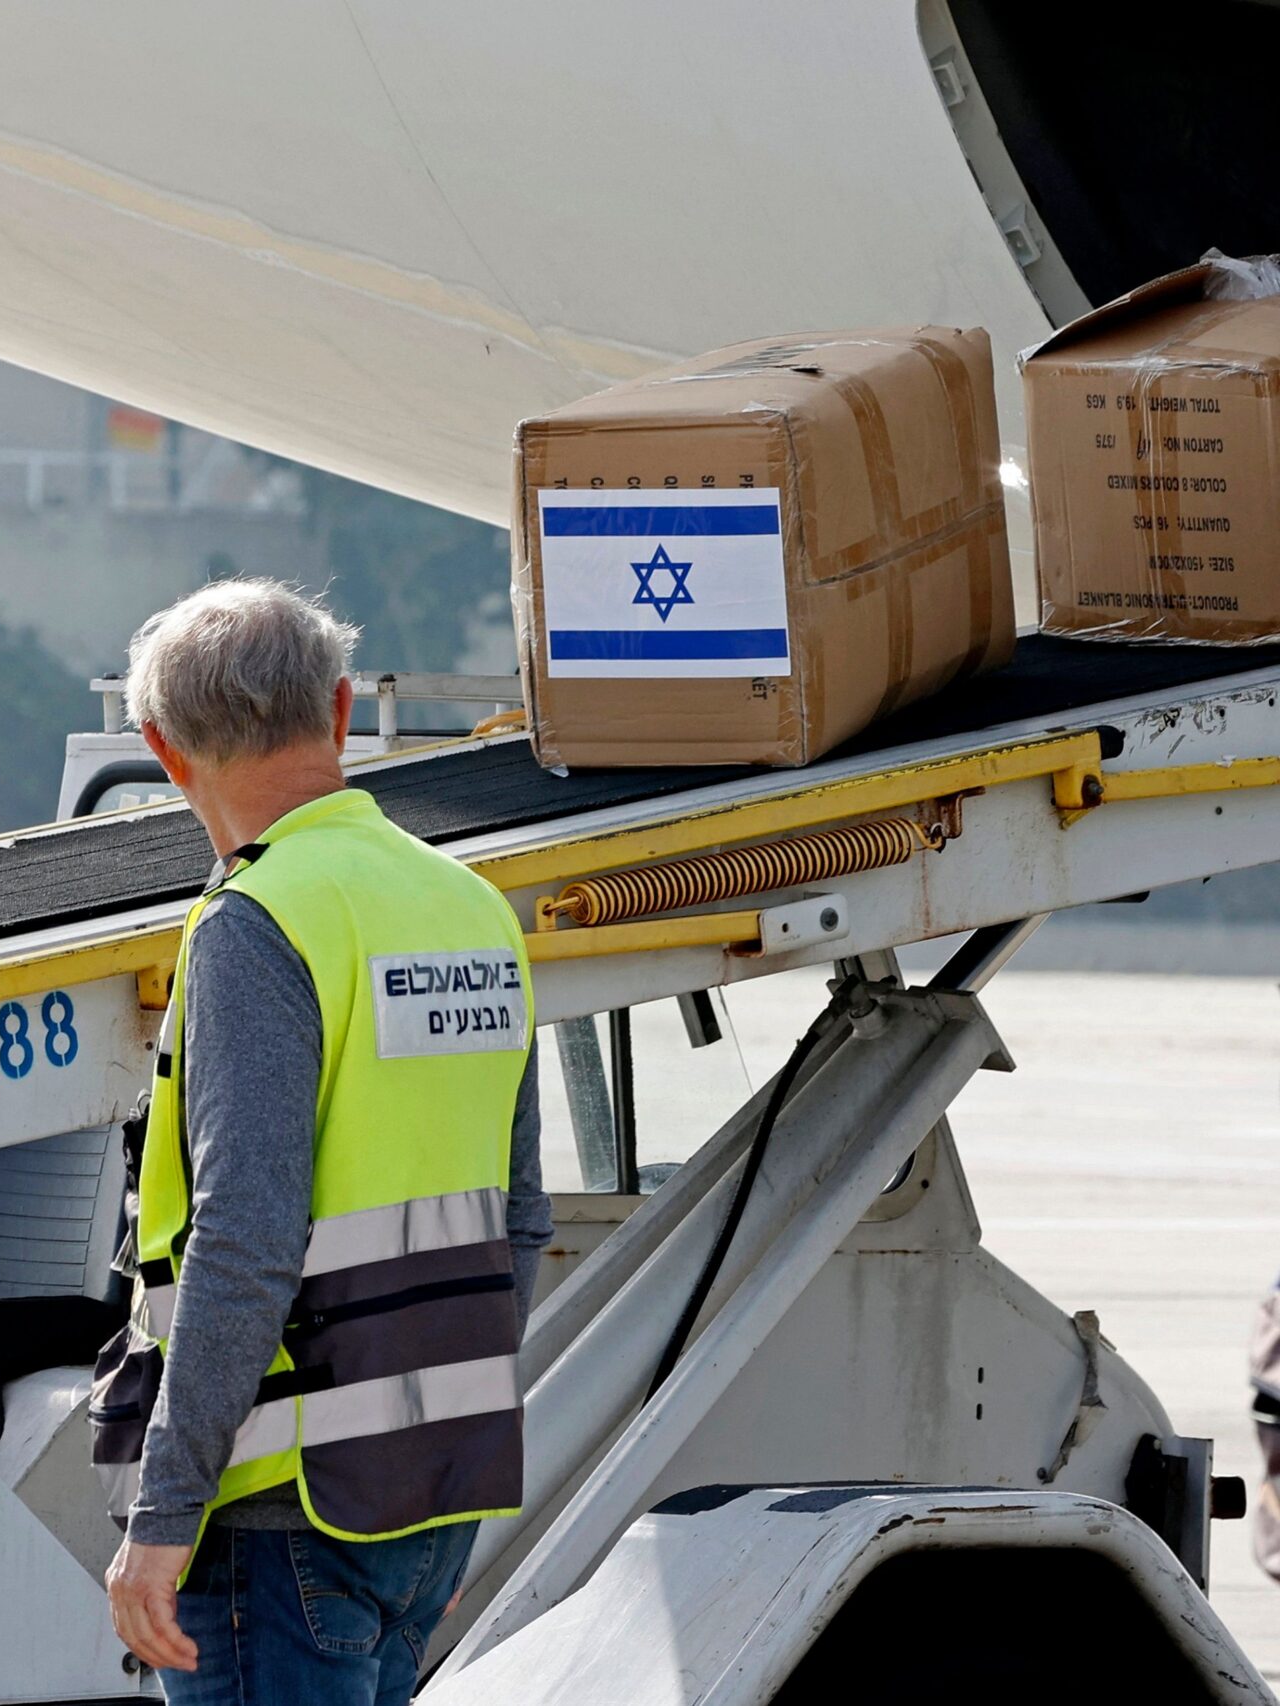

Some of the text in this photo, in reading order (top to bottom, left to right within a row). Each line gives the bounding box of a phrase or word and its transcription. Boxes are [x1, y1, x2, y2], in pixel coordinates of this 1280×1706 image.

[1086, 394, 1106, 409] KGS
[1116, 395, 1136, 411] 19.9
[1190, 398, 1221, 413] TOTAL
[1163, 438, 1181, 452] NO:
[1183, 438, 1224, 453] CARTON
[1107, 474, 1227, 493] COLOR: 8 COLORS MIXED
[1134, 515, 1152, 530] PCS
[1177, 517, 1231, 532] QUANTITY:
[1209, 557, 1235, 572] SIZE:
[1078, 591, 1122, 607] BLANKET
[1189, 595, 1239, 611] PRODUCT:
[428, 1006, 511, 1035] מבצעים
